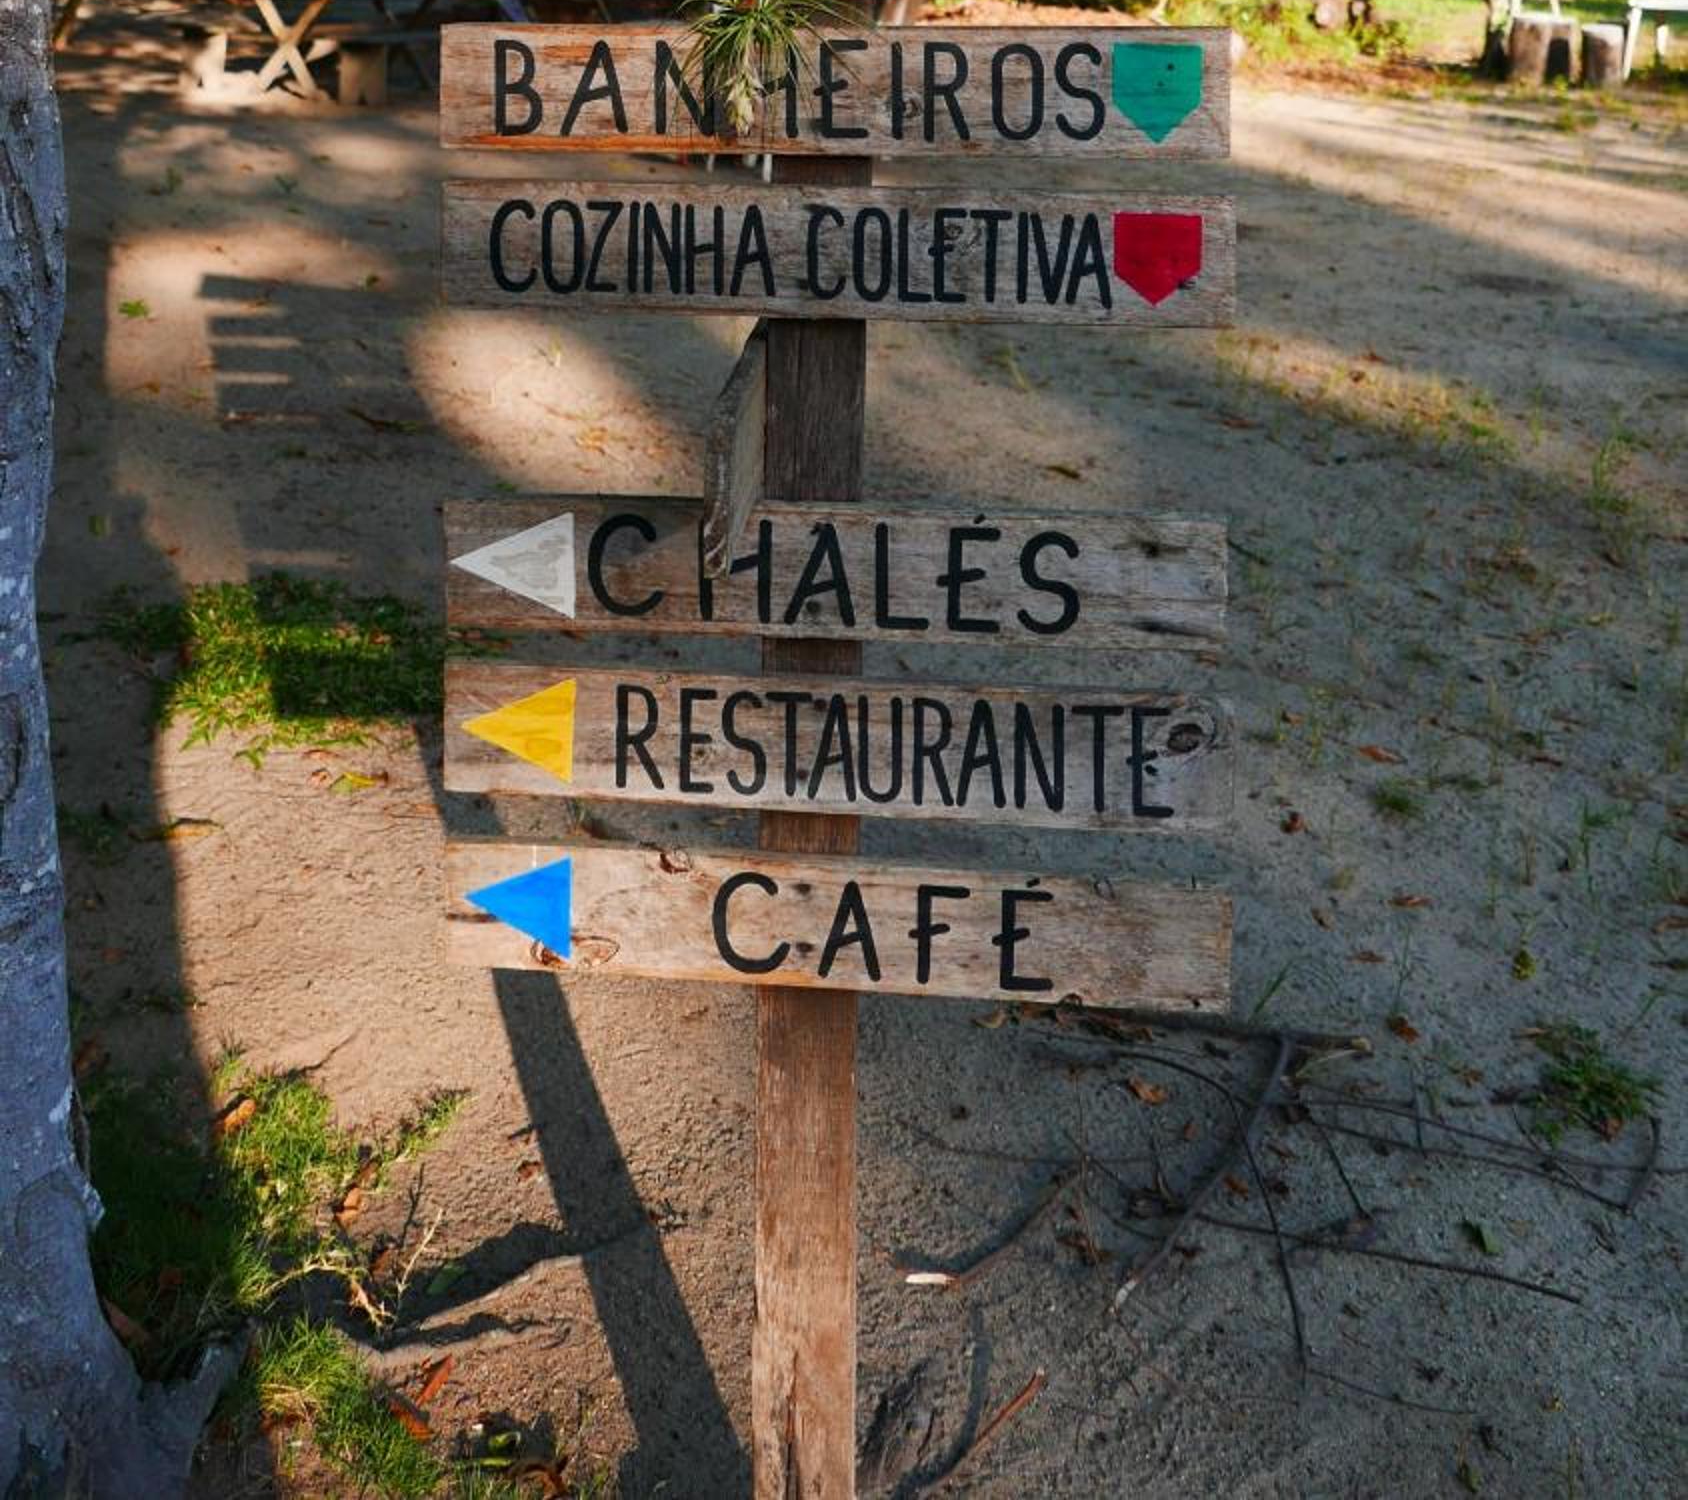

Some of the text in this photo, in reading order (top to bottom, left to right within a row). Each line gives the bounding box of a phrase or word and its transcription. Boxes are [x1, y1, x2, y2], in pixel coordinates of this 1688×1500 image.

[489, 199, 1113, 310] COZINHA COLETIVA
[587, 513, 1081, 635] CHALÉS
[614, 683, 1175, 818] RESTAURANTE
[711, 871, 1054, 992] CAFÉ
